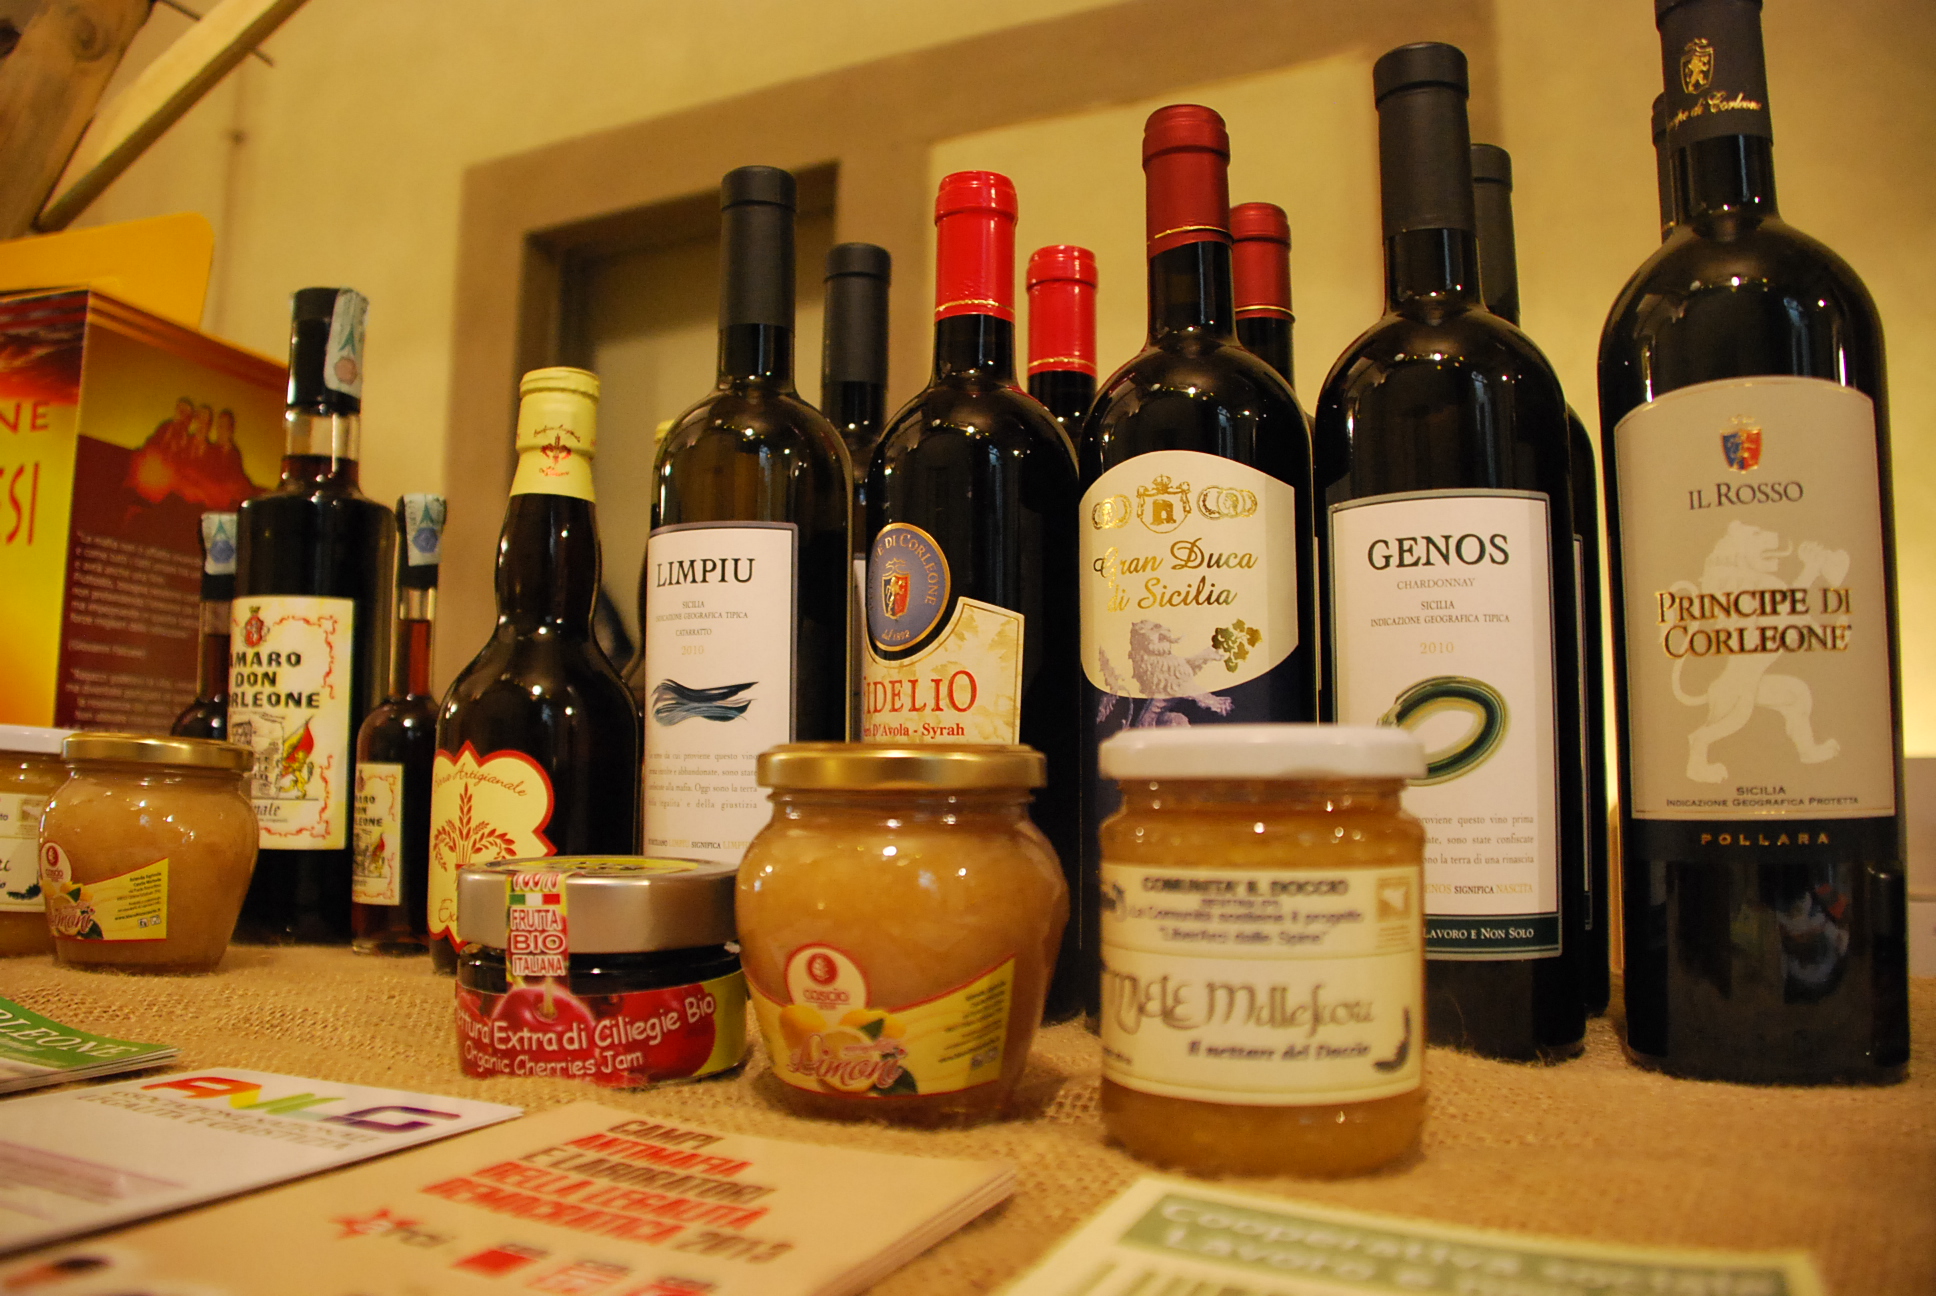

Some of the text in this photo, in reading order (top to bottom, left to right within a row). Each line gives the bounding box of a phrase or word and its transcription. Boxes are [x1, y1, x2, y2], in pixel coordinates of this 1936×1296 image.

[1688, 489, 1711, 510] IL
[1368, 533, 1510, 570] GENOS
[1093, 537, 1258, 588] Gran Duca
[656, 557, 755, 587] LIMPIU
[1397, 577, 1476, 590] CHARDONNAY
[1107, 575, 1238, 612] di Sicilia
[682, 601, 705, 609] SICILIA
[1421, 600, 1455, 610] SICILIA
[1821, 587, 1853, 615] DI
[684, 612, 722, 620] GEOGRAFICA
[726, 611, 748, 619] TIPICA
[1371, 614, 1510, 627] INDICAZIONE GEOGRAFICA TIPICA
[675, 628, 712, 637] CATARRATTO
[1420, 642, 1455, 654] 2010
[235, 671, 277, 688] DON
[864, 670, 978, 714] IDELIO
[921, 723, 965, 739] Syrah
[683, 751, 710, 761] proviene
[714, 753, 738, 762] questo
[454, 763, 527, 797] Artigianale
[694, 783, 711, 794] Oggi
[731, 783, 738, 793] la
[740, 785, 757, 793] terra
[1736, 786, 1786, 796] SICILIA
[696, 799, 714, 808] della
[721, 800, 757, 811] giustizia
[1457, 816, 1486, 827] questo
[1490, 814, 1507, 824] vino
[1512, 813, 1534, 827] prima
[690, 841, 721, 849] SIGNIFICA
[1447, 837, 1467, 845] sono
[1472, 835, 1491, 845] state
[1497, 833, 1534, 844] confiscate
[1701, 832, 1829, 846] POLLARA
[1440, 853, 1448, 864] la
[1450, 856, 1471, 865] terra
[1474, 853, 1482, 865] di
[1485, 857, 1500, 865] una
[1502, 854, 1534, 865] rinascita
[1425, 883, 1533, 894] ENOS SIGNIFICA NASCITA
[510, 907, 562, 931] FRUTTA
[511, 931, 566, 954] BIO
[512, 955, 567, 976] ITALIANA
[494, 1021, 558, 1051] Extra
[563, 1021, 587, 1050] di
[594, 1011, 681, 1047] Ciliegie
[684, 995, 715, 1024] Bio
[464, 1040, 643, 1075] Organic Cherries Jam
[606, 1119, 726, 1150] CAMPI
